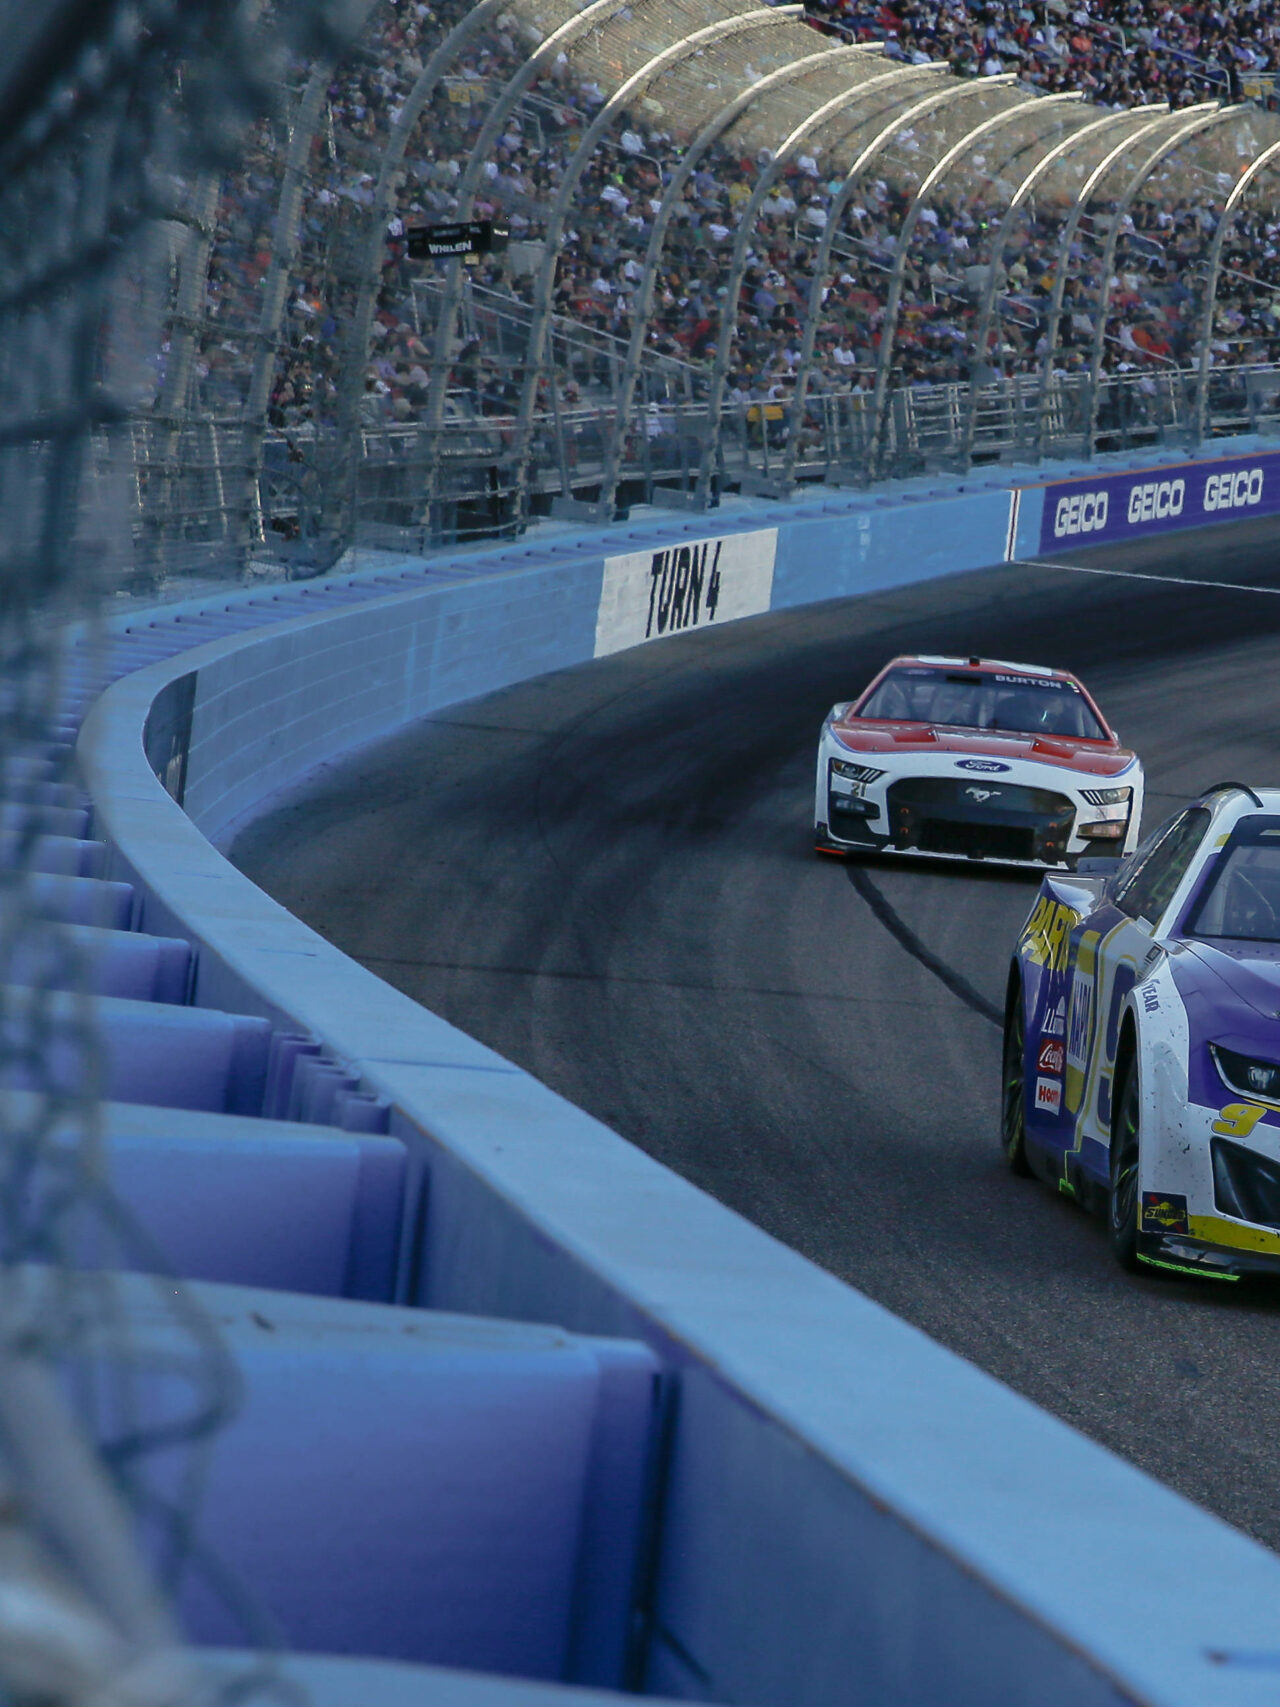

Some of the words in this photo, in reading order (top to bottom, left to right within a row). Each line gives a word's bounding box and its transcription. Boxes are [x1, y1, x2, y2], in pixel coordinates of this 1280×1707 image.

[1054, 491, 1109, 538] GEICO
[1128, 479, 1186, 525] GEICO
[1203, 469, 1263, 512] GEICO
[645, 543, 709, 639] TURN
[705, 541, 723, 622] 4
[995, 674, 1062, 689] BURTON
[1211, 1103, 1267, 1138] 9
